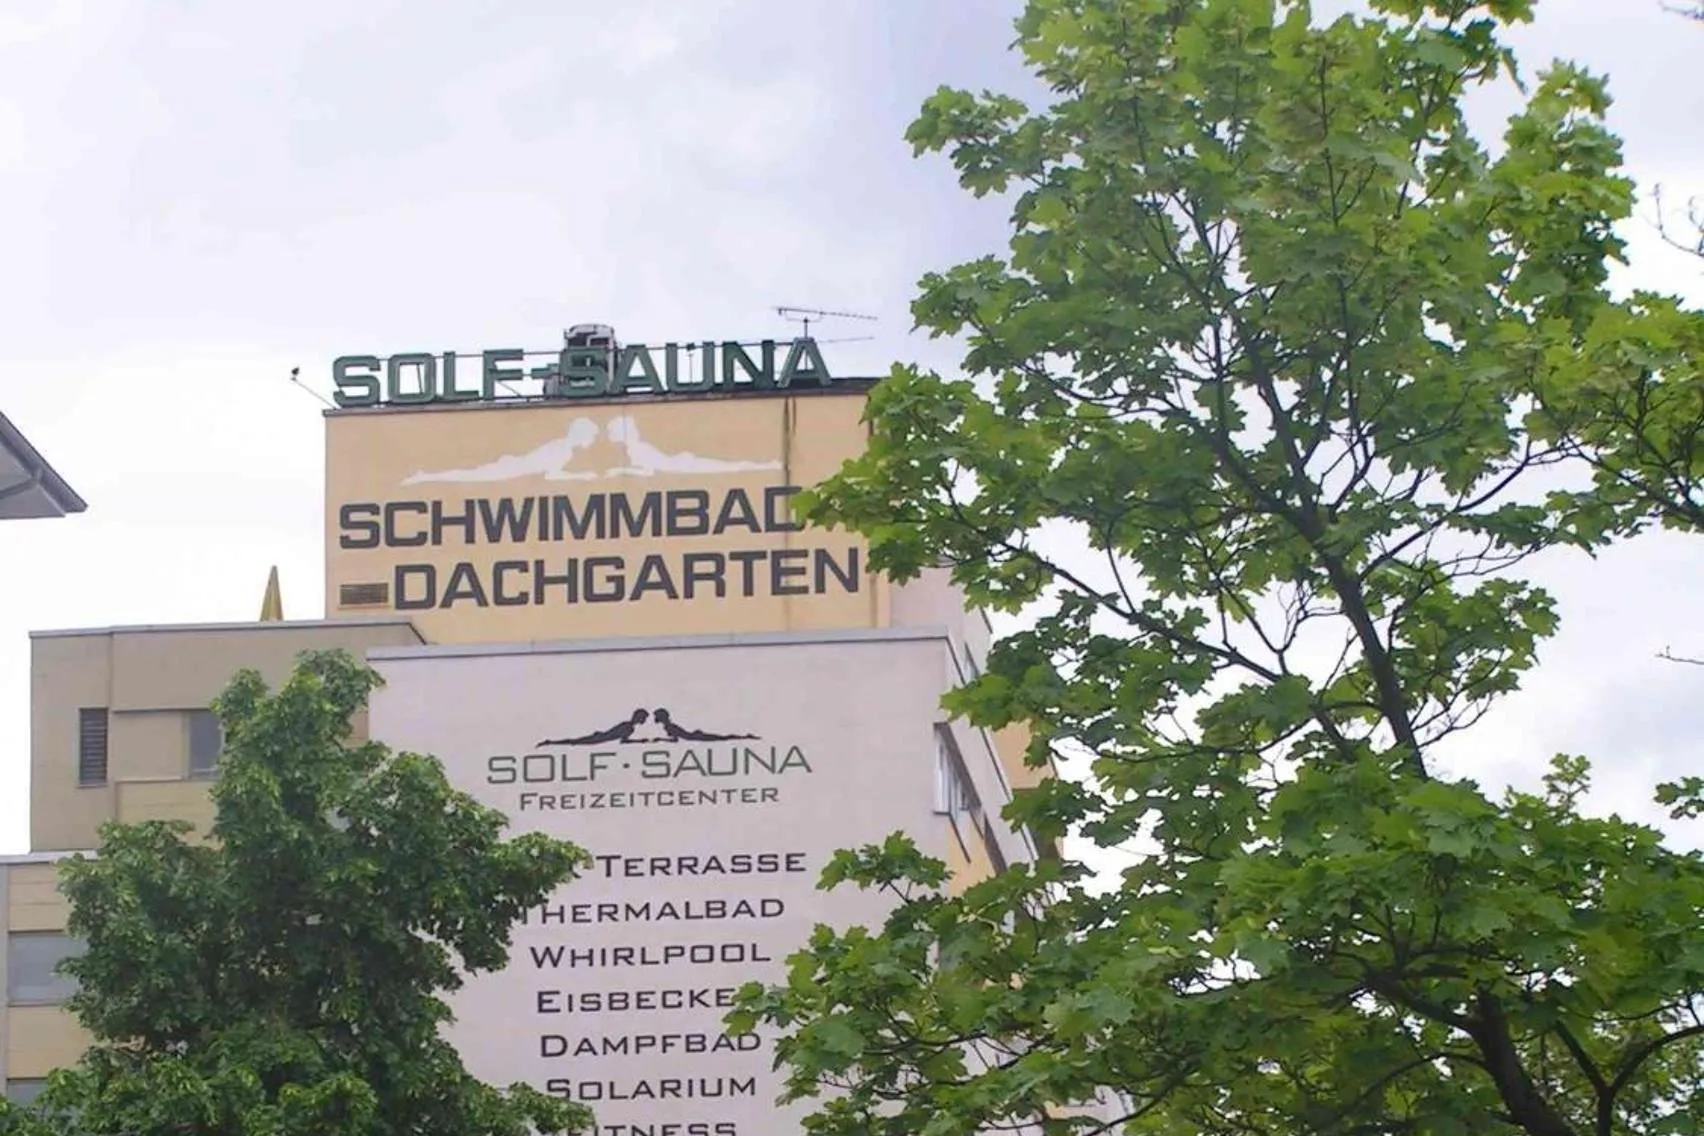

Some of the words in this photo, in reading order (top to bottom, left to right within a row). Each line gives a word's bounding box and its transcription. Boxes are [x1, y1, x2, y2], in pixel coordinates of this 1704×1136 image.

[394, 547, 859, 611] DACHGARTEN
[519, 787, 780, 812] FREIZEITCENTER
[530, 943, 771, 969] WHIRLPOOL
[541, 1032, 762, 1058] DAMPFBAD
[547, 1077, 756, 1101] SOLARIUM
